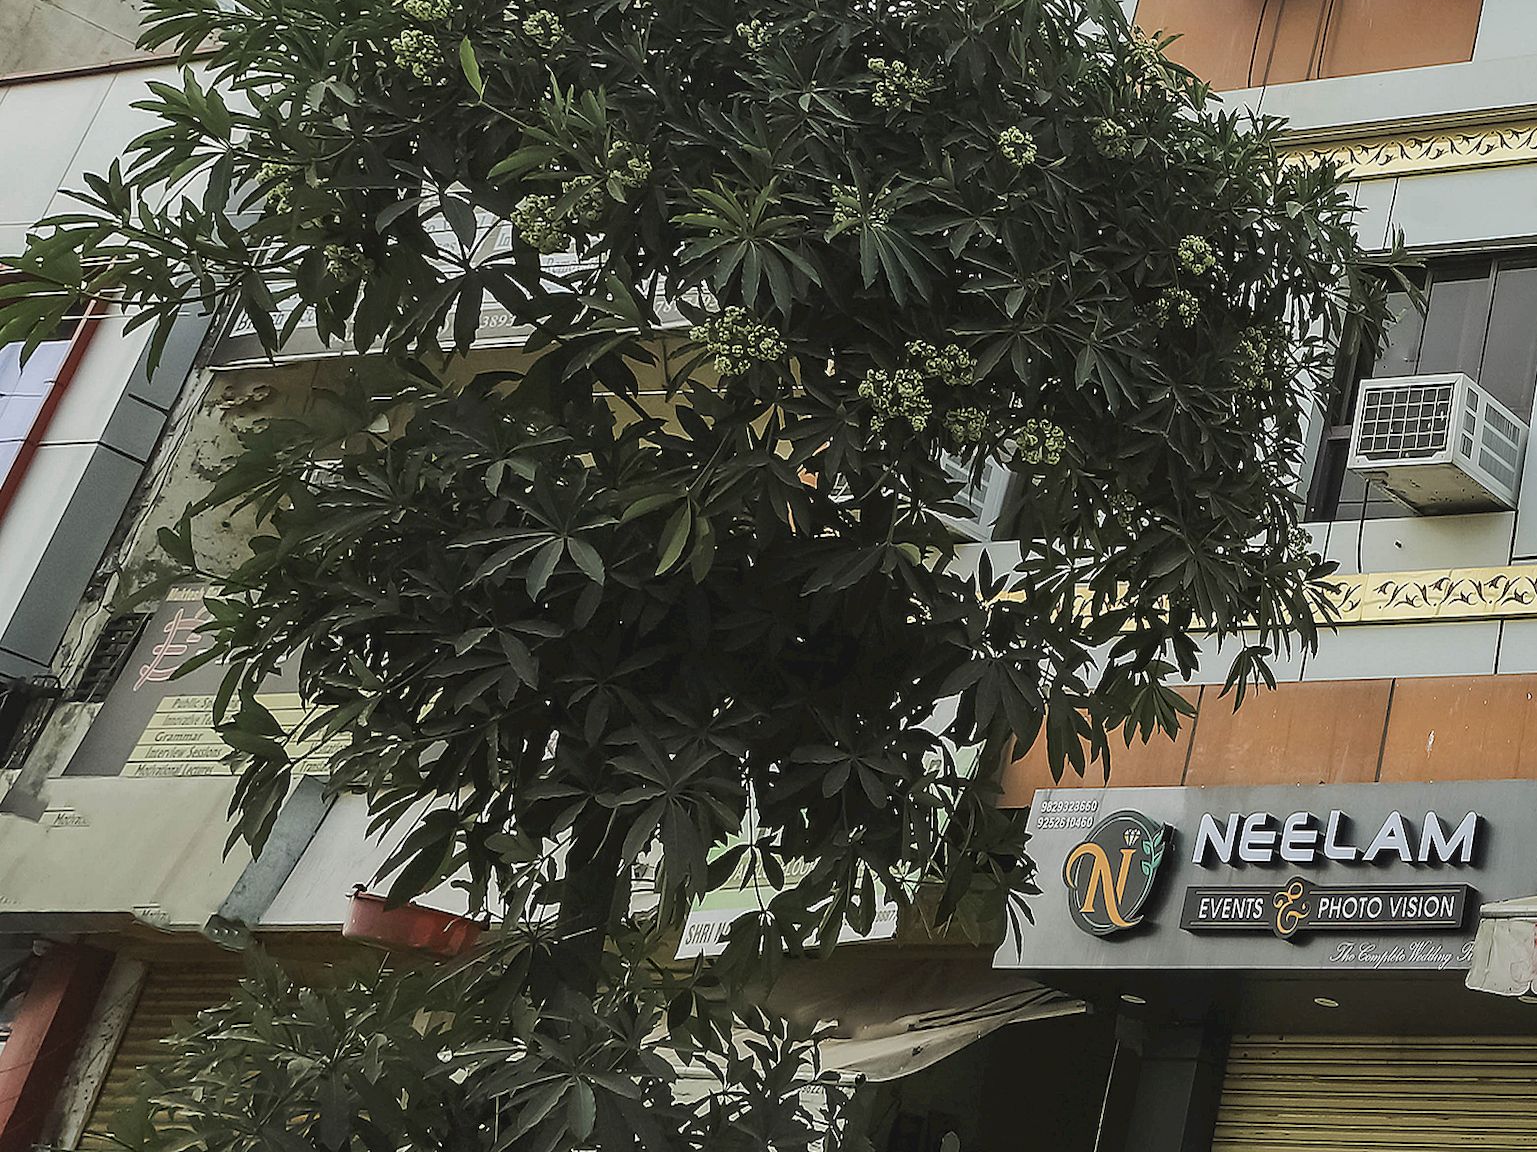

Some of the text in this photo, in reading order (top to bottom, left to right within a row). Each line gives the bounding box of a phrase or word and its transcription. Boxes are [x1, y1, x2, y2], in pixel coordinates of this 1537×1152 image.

[154, 731, 203, 743] Grammar
[144, 747, 186, 759] Interview
[1191, 809, 1478, 864] NEELAM
[1198, 881, 1455, 935] EVENTS & PHOTO VISION
[685, 923, 717, 946] SHRI
[1330, 941, 1356, 962] The
[1357, 941, 1407, 970] Complete
[1408, 940, 1453, 970] Wedding
